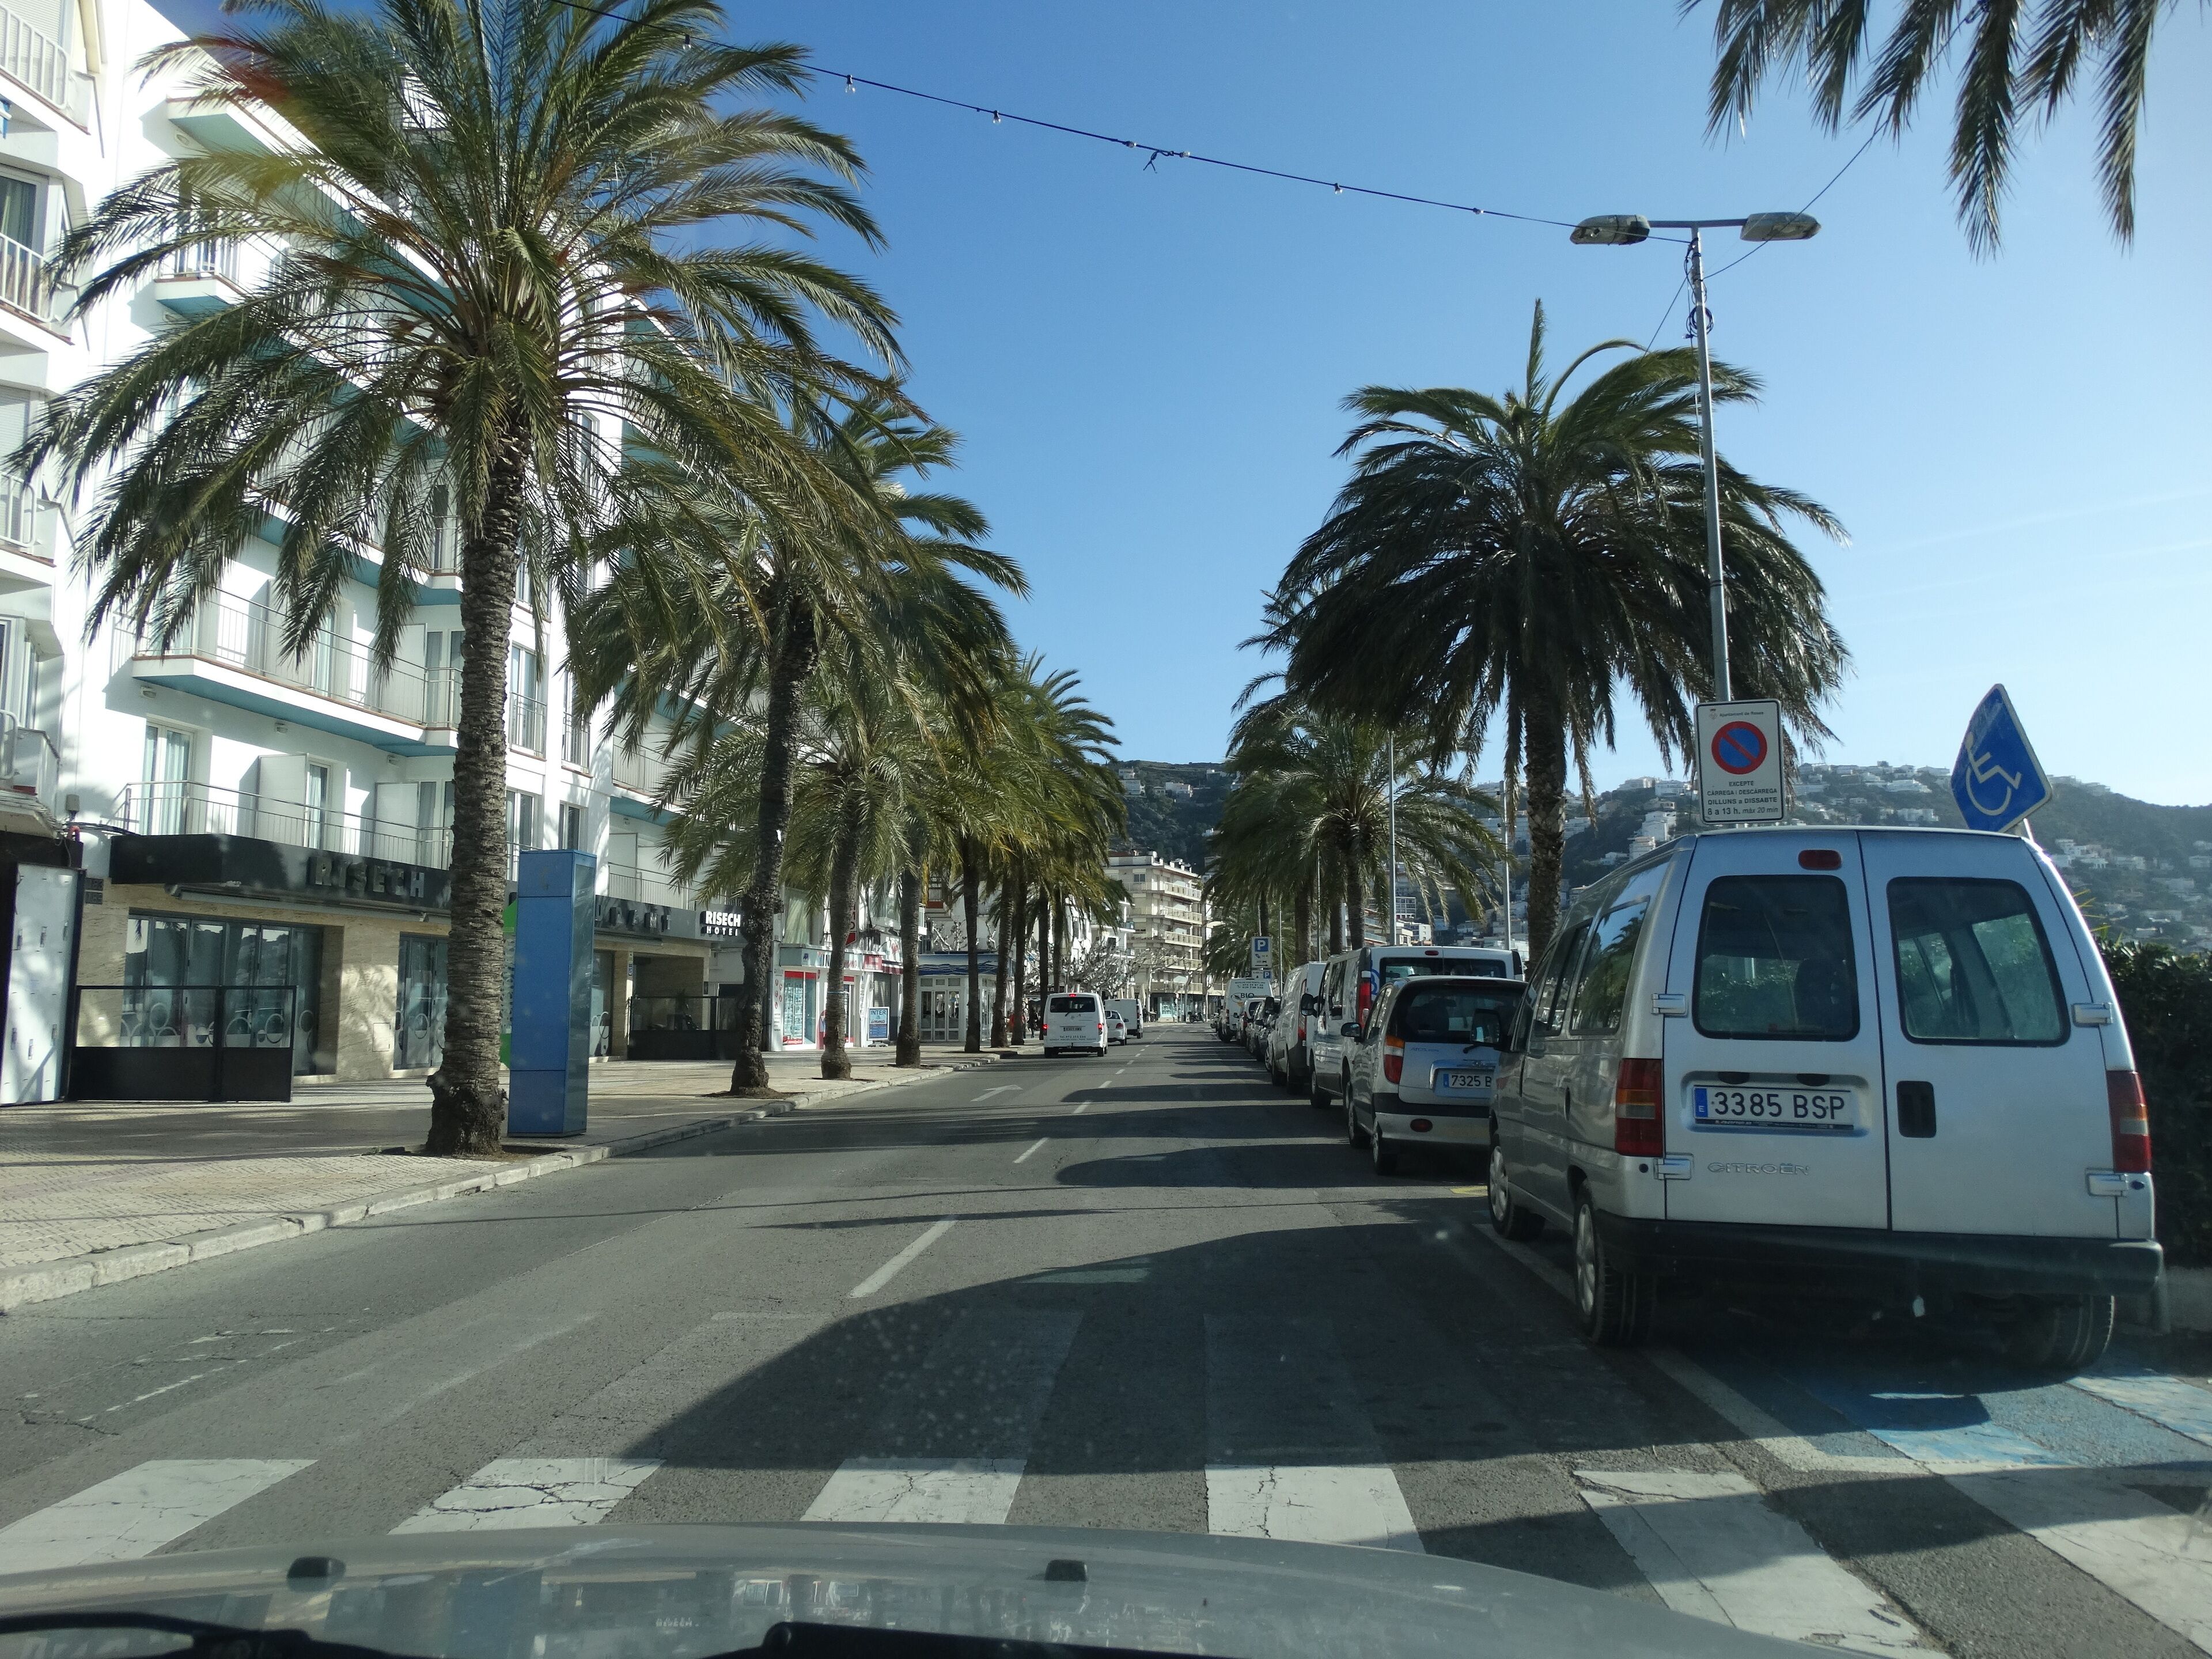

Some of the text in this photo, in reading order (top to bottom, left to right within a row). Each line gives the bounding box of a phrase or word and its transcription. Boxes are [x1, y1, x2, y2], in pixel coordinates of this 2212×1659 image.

[315, 856, 425, 898] RISECH
[705, 911, 741, 927] RISECH
[1451, 1075, 1481, 1086] 7325
[1714, 1092, 1844, 1120] 3385 BSP
[1707, 1162, 1810, 1175] CITROËN
